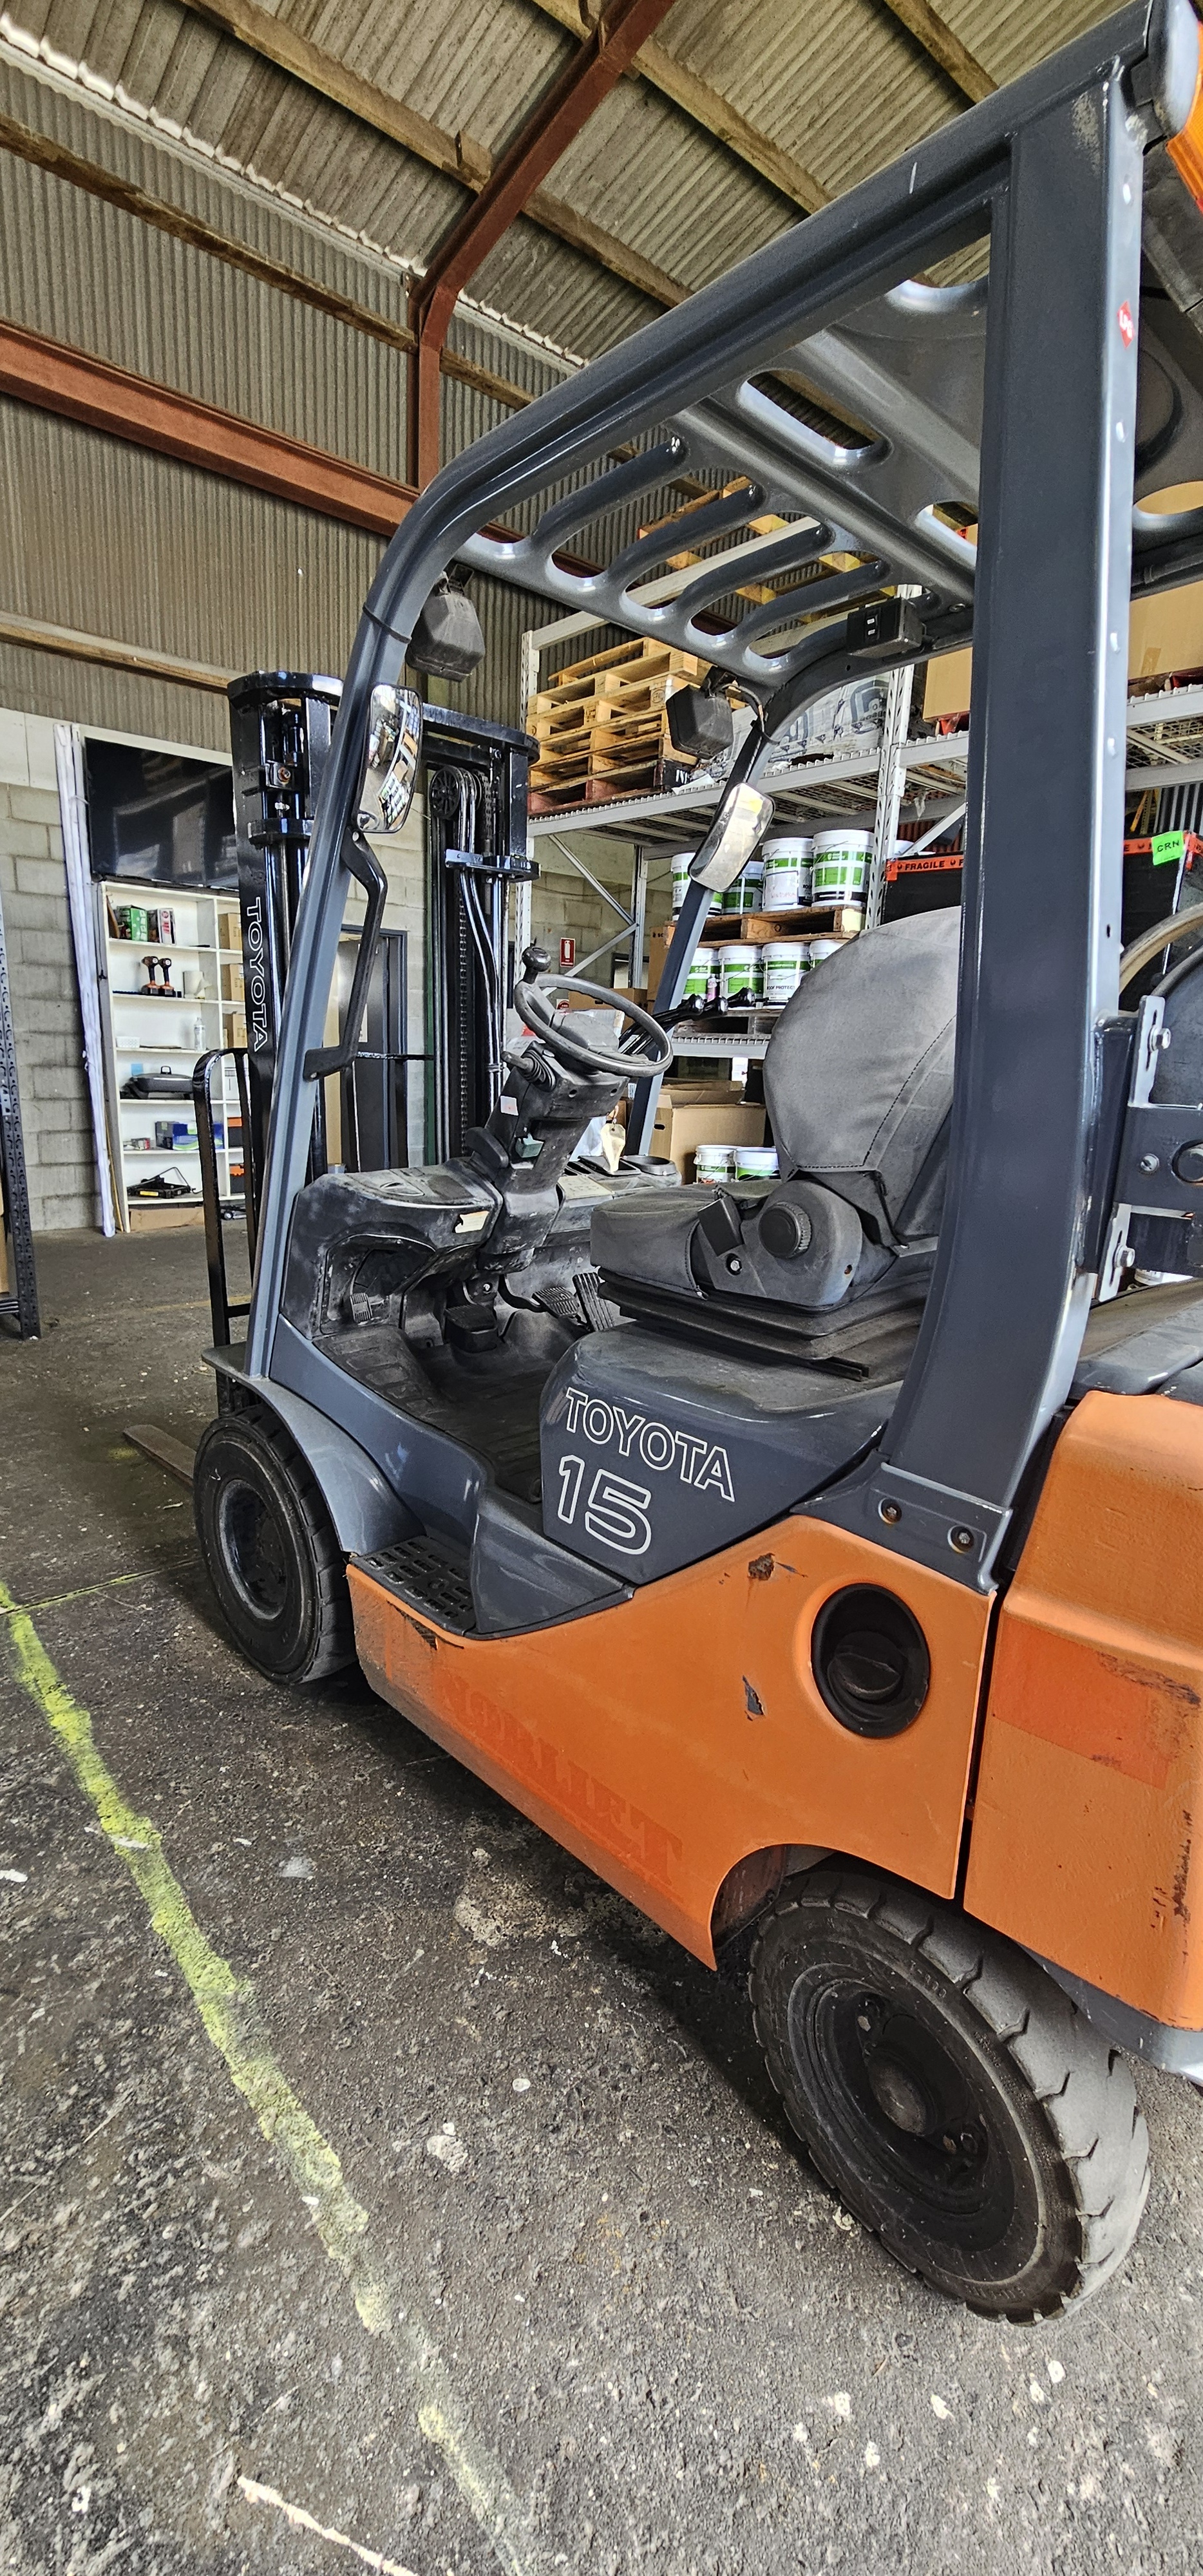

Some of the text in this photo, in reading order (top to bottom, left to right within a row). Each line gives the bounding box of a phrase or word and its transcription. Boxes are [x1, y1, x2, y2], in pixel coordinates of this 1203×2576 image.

[905, 860, 945, 871] FRAGILE
[1157, 840, 1180, 853] CRN
[247, 896, 268, 1052] TOYOTA
[565, 1387, 735, 1502] TOYOTA
[558, 1454, 652, 1555] 15
